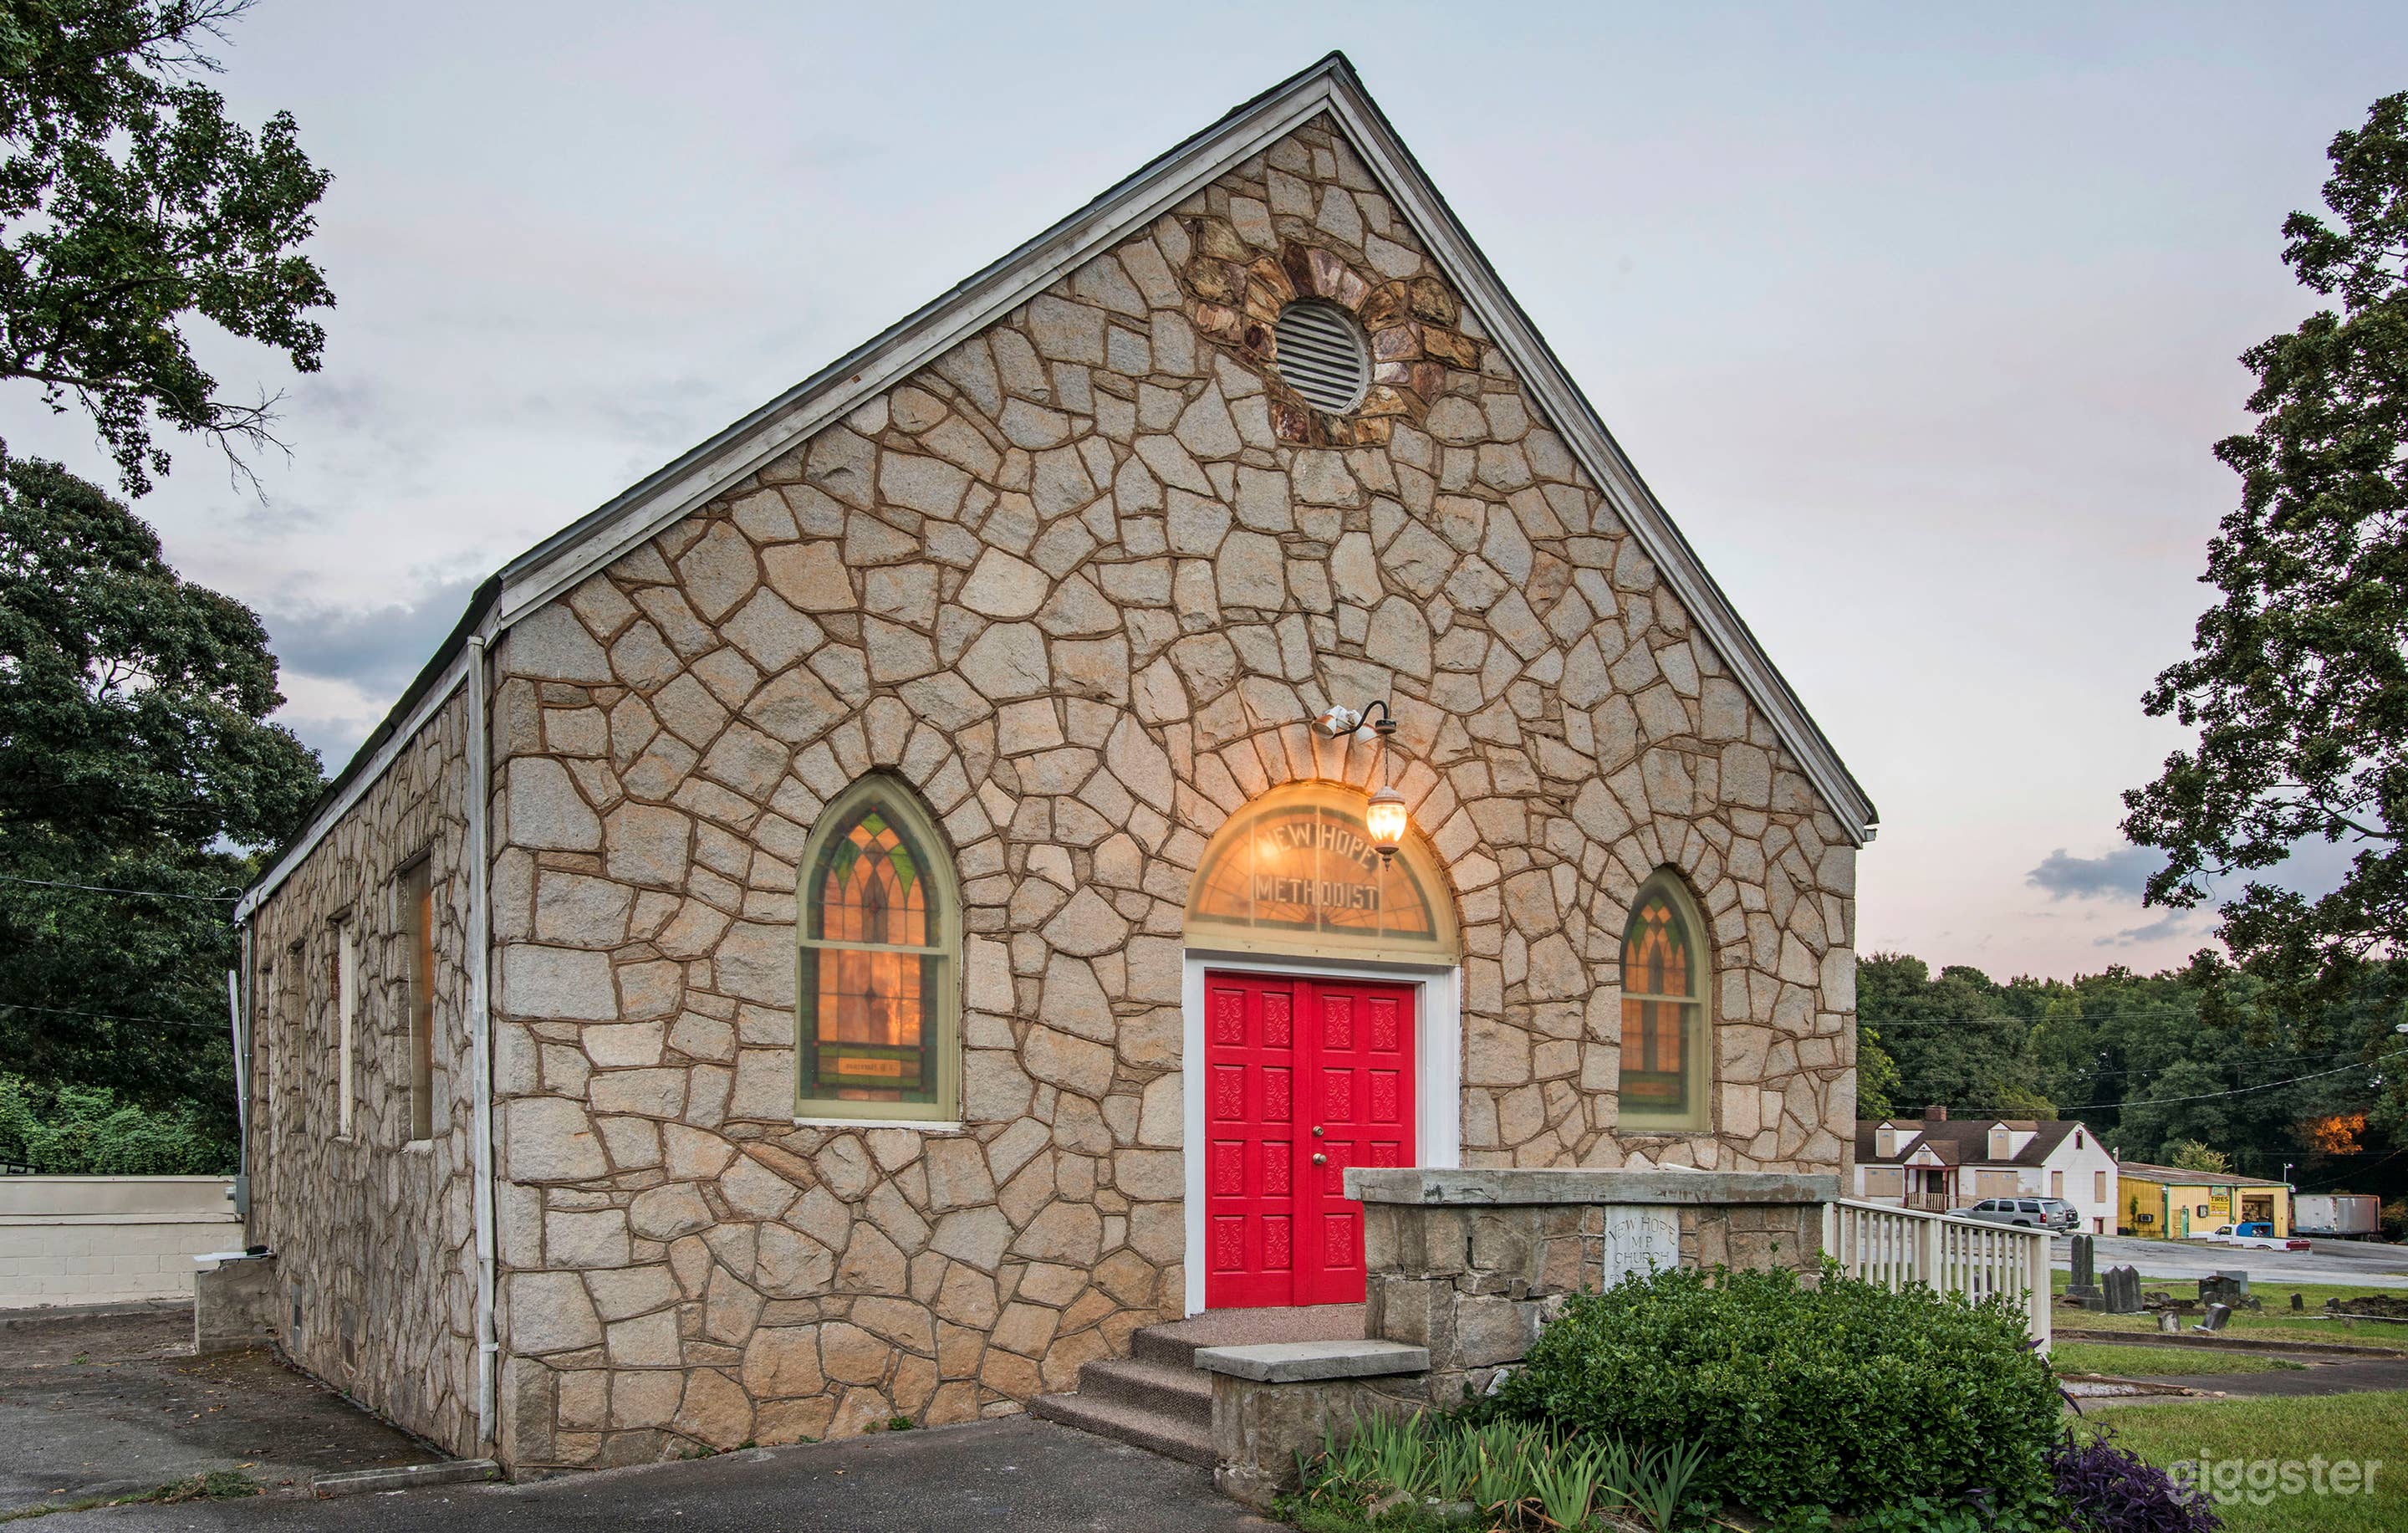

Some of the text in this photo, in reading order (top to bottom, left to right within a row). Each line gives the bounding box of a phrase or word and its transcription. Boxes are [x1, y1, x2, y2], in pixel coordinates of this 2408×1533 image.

[1256, 823, 1377, 870] NEW HOPE
[1255, 875, 1378, 910] METHODIST
[1608, 1217, 1676, 1245] NEW HOPE
[1632, 1236, 1652, 1248] M P
[1615, 1251, 1669, 1264] CHURCH
